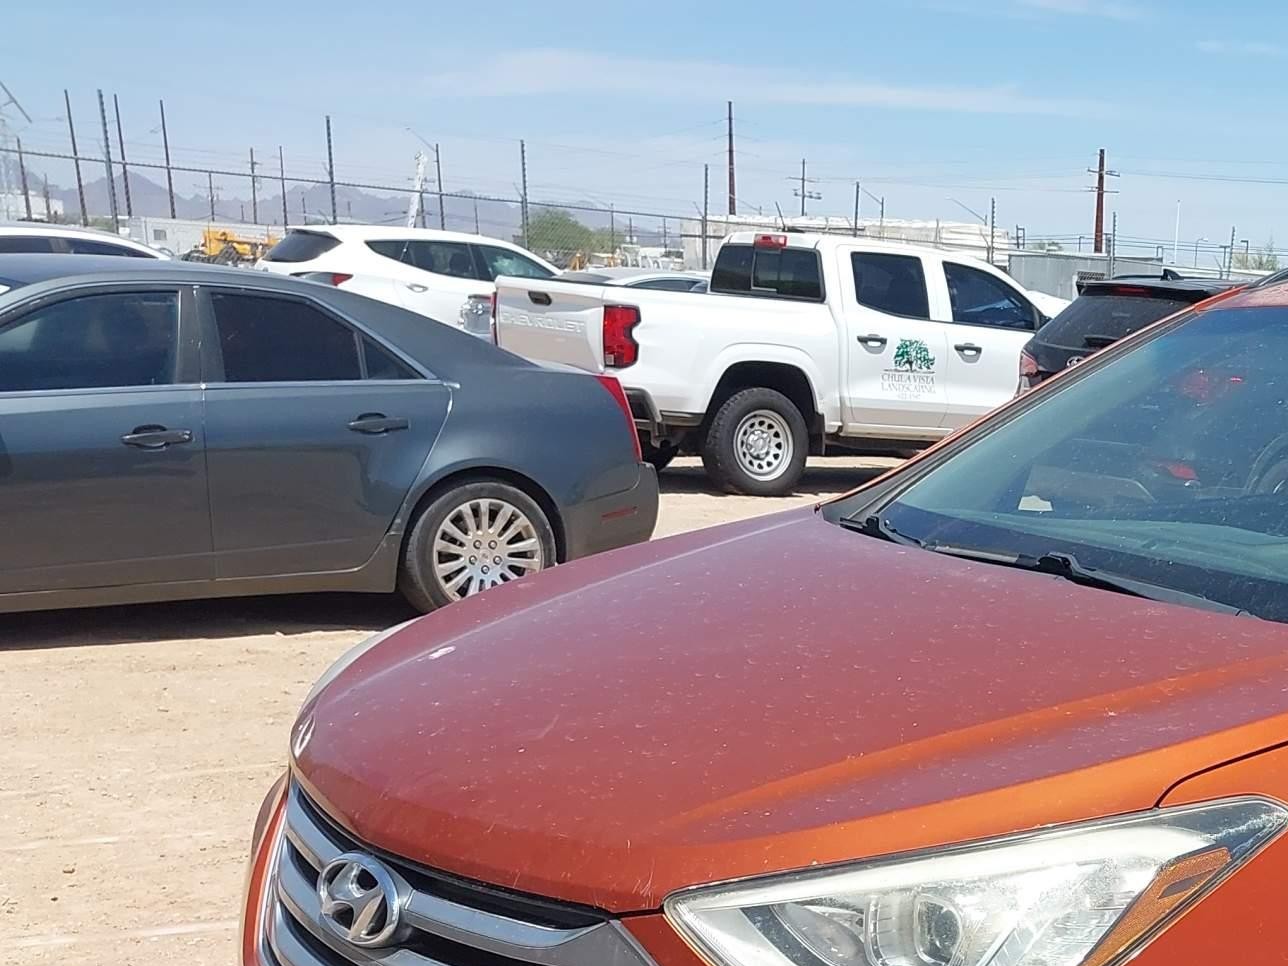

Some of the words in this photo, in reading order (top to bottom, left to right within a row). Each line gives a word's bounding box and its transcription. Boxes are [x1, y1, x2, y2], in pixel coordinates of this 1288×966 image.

[500, 312, 585, 333] CHEVROLET
[881, 373, 911, 383] CHULA
[912, 375, 935, 385] VISTA
[881, 382, 936, 394] LANDSCAPING
